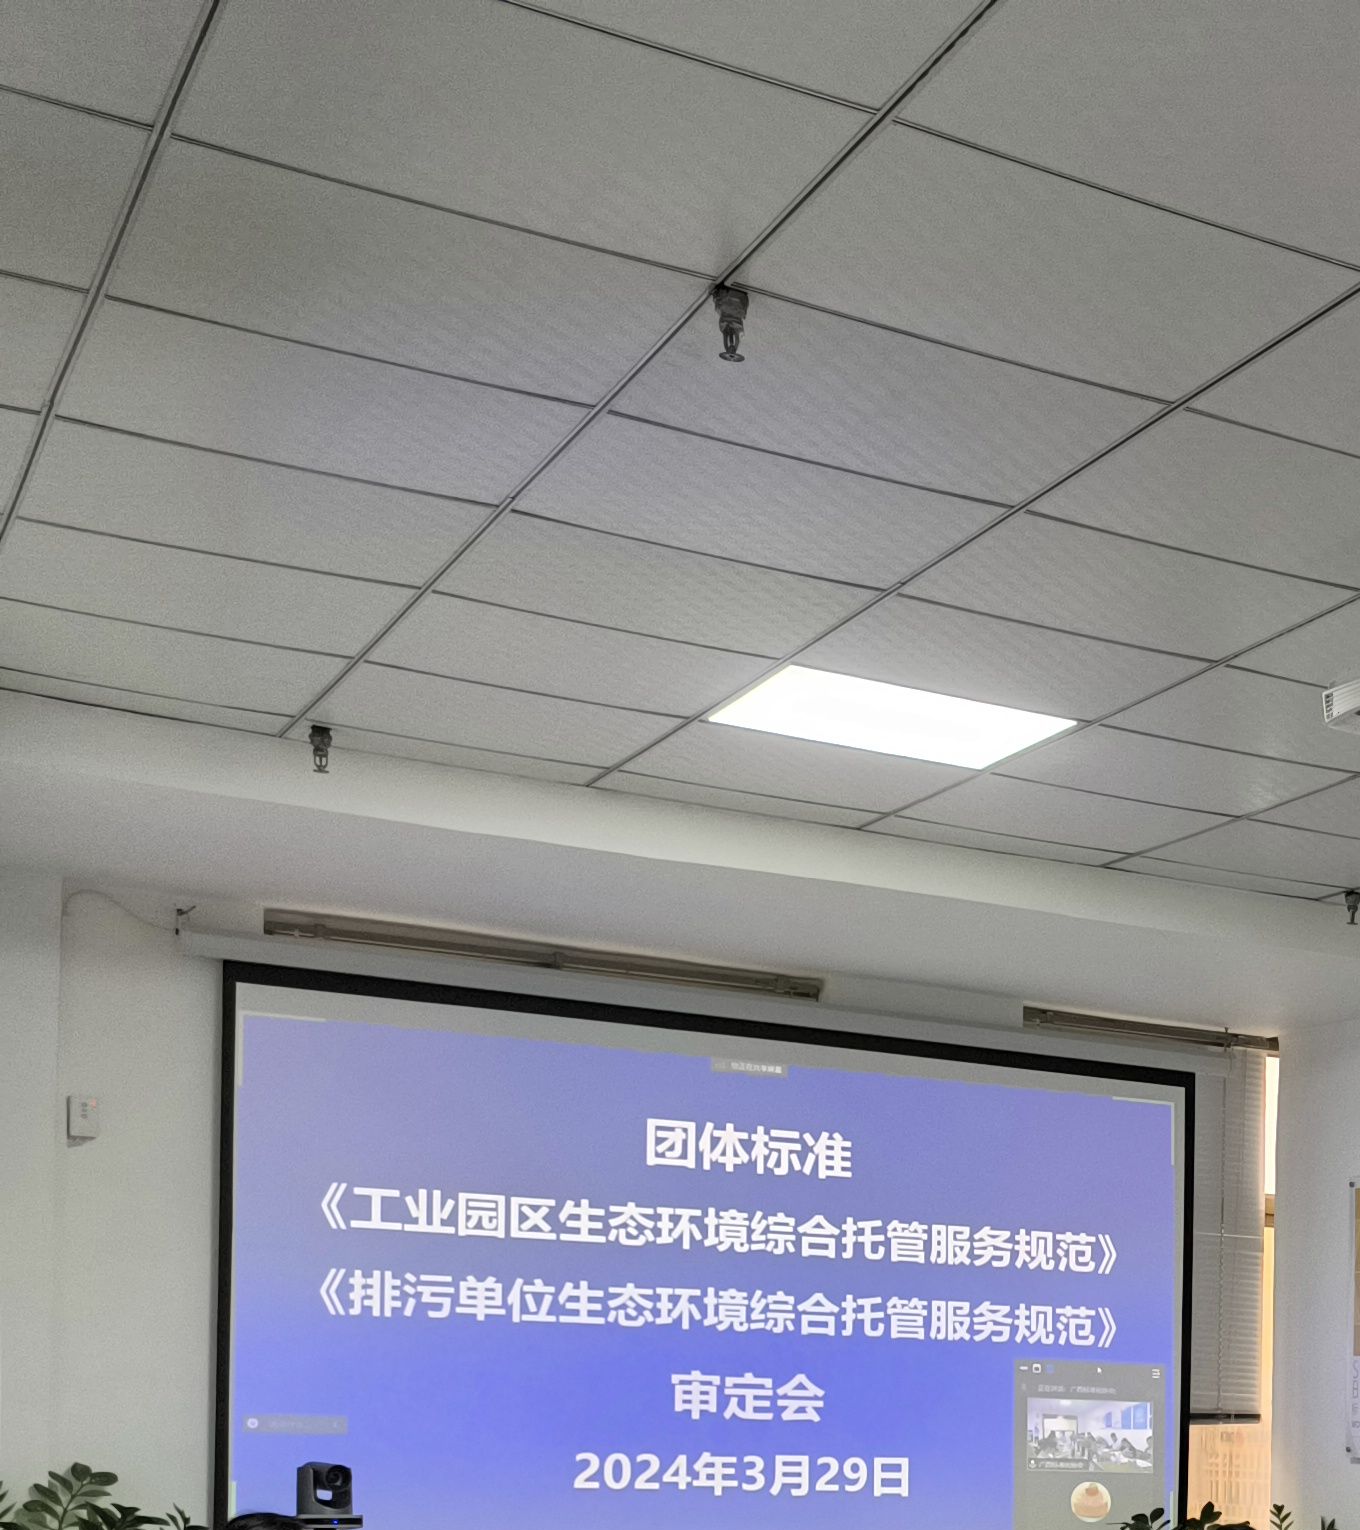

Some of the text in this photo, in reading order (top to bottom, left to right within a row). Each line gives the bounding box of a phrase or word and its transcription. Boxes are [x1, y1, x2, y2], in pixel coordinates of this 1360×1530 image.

[645, 1117, 853, 1180] 团体标准
[319, 1182, 1120, 1277] 《工业园区生态环境综合托管服务规范》
[317, 1268, 1120, 1350] 《排污单位生态环境综合托管服务规范》
[671, 1369, 827, 1425] 审定会
[572, 1451, 912, 1499] 2024年3月29日
